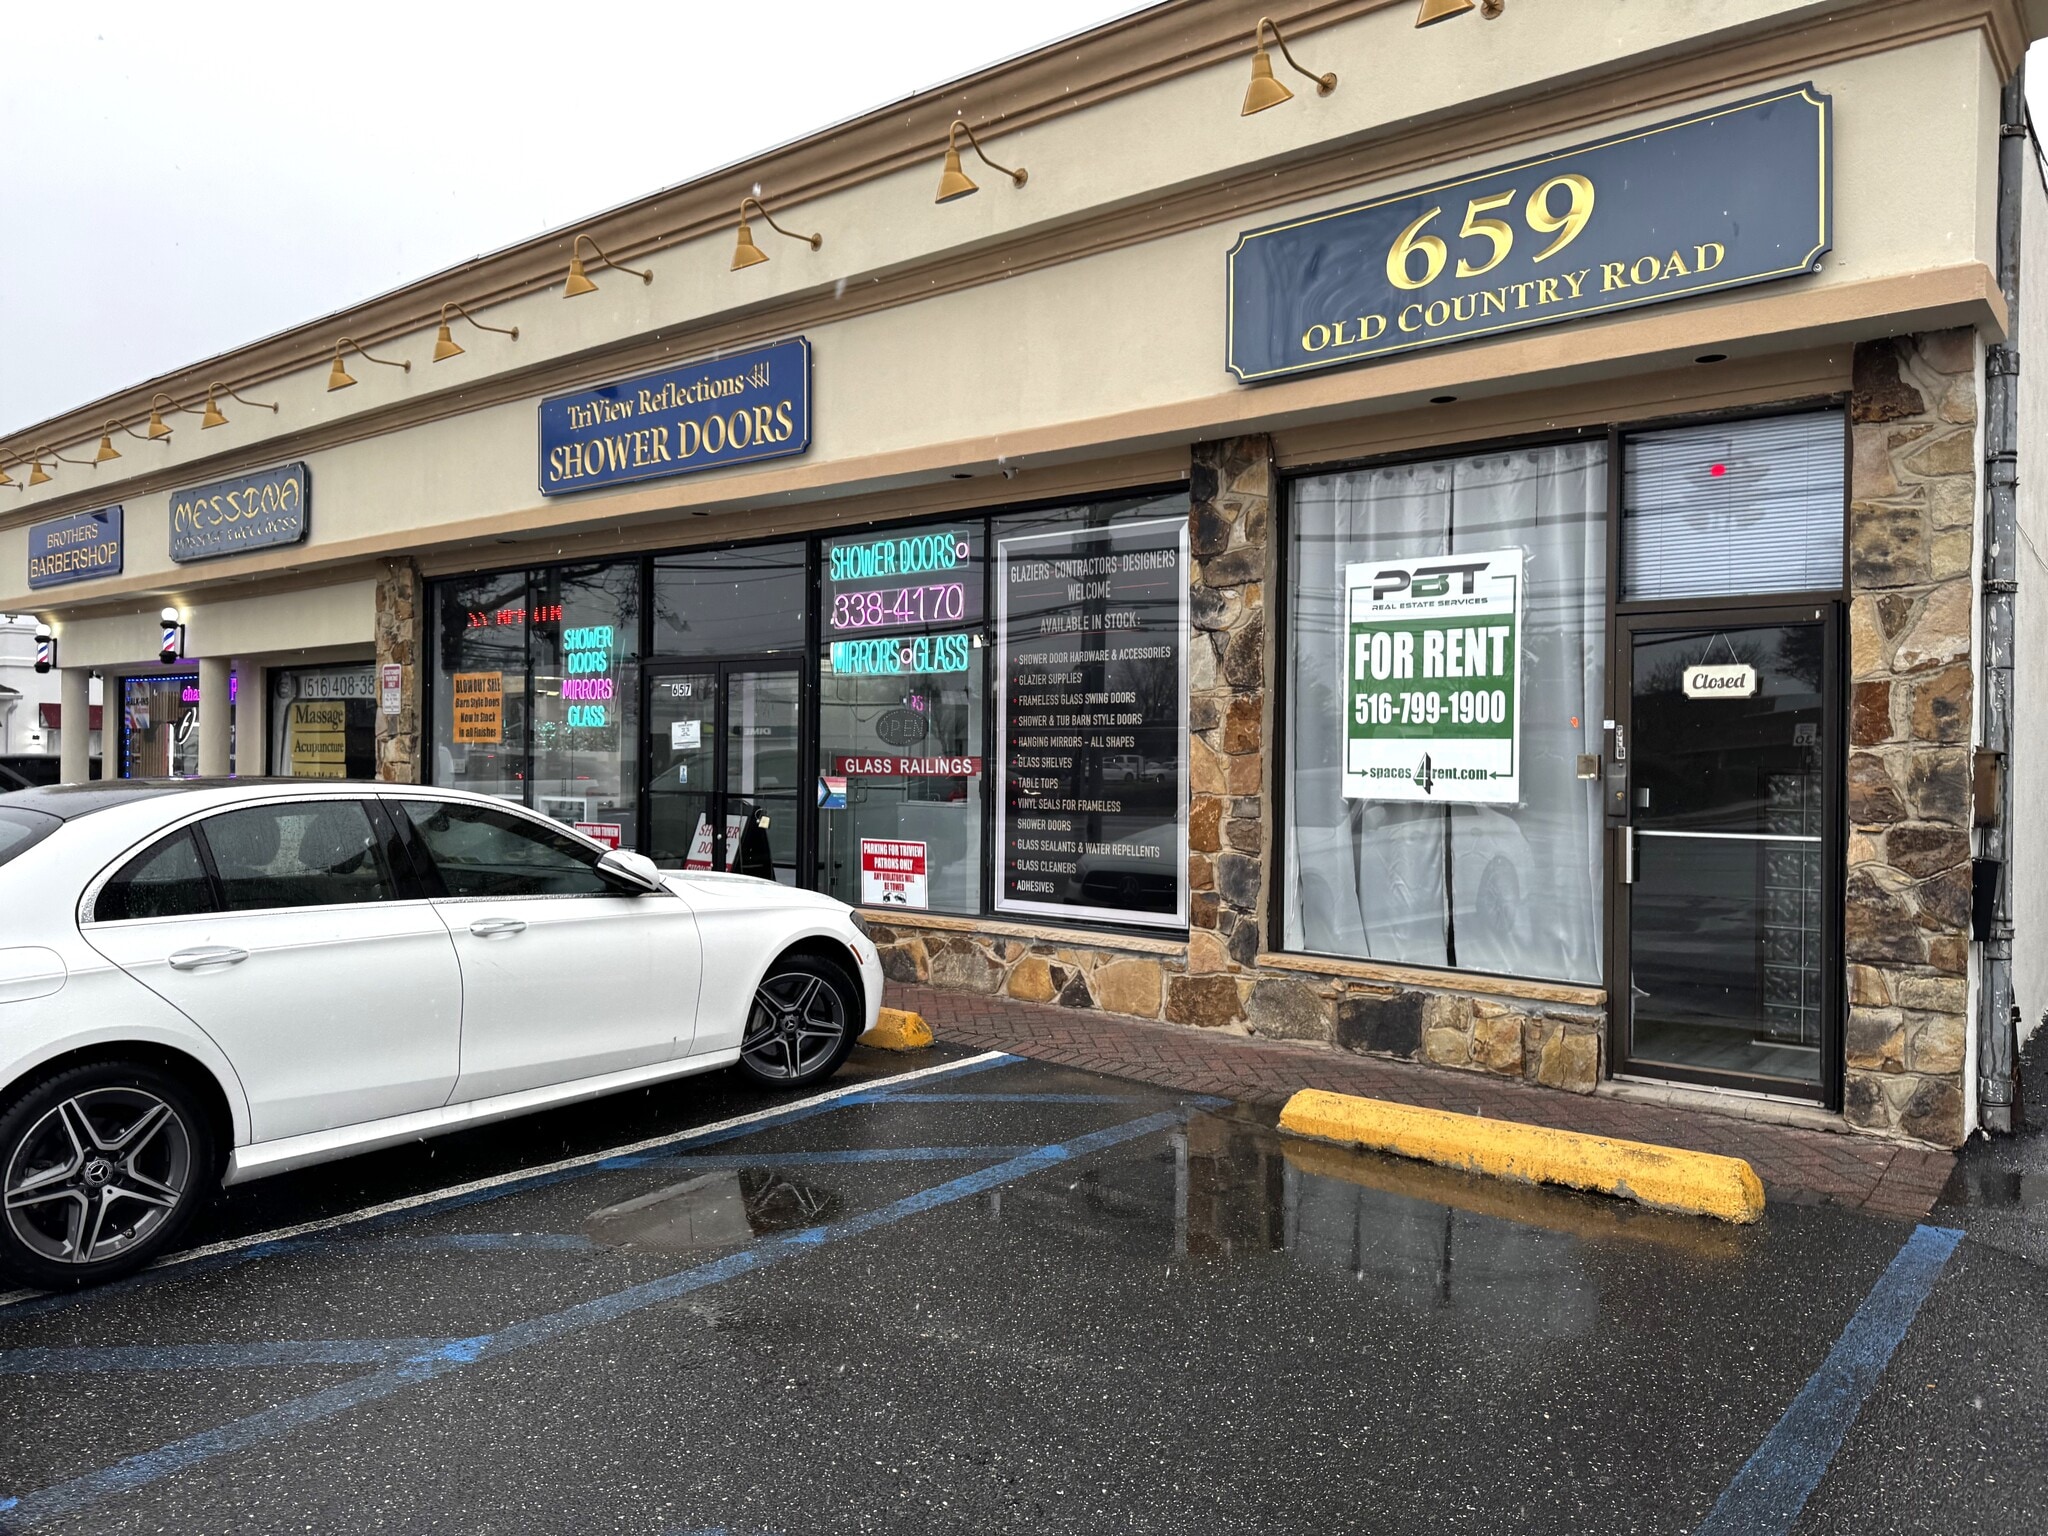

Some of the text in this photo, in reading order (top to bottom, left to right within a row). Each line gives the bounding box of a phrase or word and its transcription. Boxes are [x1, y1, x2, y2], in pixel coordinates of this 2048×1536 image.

[1385, 173, 1596, 290] 659
[1300, 241, 1726, 353] OLD COUNTRY ROAD
[567, 374, 745, 430] TriView Reflections
[550, 400, 794, 482] SHOWER DOORS
[174, 478, 299, 533] MESSINA
[47, 523, 98, 549] BROTHERS
[30, 542, 117, 578] BARBERSHOP
[830, 533, 956, 580] SHOWER DOORS
[1067, 581, 1111, 601] WELCOME
[1373, 562, 1491, 601] PBT
[835, 585, 963, 627] 338-4170
[1372, 597, 1489, 611] REAL ESTATE SERVICES
[1040, 612, 1141, 634] AVAILABLE IN STOCK:
[563, 626, 613, 650] SHOWER
[568, 651, 607, 674] DOORS
[833, 634, 968, 674] MIRRORS GLASS
[1019, 646, 1171, 665] SHOWER DOOR HARDWARE & ACCESSORIES
[1354, 625, 1510, 681] FOR RENT
[304, 676, 375, 697] (516)408-38
[562, 678, 613, 700] MIRRORS
[1019, 673, 1082, 686] GLAZIER SUPPLIES
[1692, 673, 1746, 690] Closed
[672, 684, 691, 696] 657
[1018, 692, 1136, 706] FRAMELESS GLASS SWING DOORS
[456, 697, 500, 708] Barn Style Doors
[1355, 689, 1506, 725] 516-799-1900
[295, 704, 344, 730] Massage
[568, 705, 606, 727] GLASS
[1018, 713, 1143, 727] SHOWER & TUB BARN STYLE DOORS
[879, 719, 924, 737] OPEN
[294, 740, 344, 757] Acupuncture
[1018, 736, 1049, 748] HANGING
[1050, 736, 1082, 748] MIRRORS
[1091, 736, 1104, 748] ALL
[1106, 736, 1135, 748] SHAPES
[845, 758, 973, 774] GLASS RAILINGS
[1018, 756, 1072, 768] GLASS SHELVES
[1018, 777, 1059, 789] TABLE TOPS
[1018, 798, 1121, 812] VINYL SEALS FOR FRAMELESS
[699, 824, 740, 839] SHER
[1017, 818, 1072, 832] SHOWER DOORS
[863, 842, 924, 858] PARKING FOR TRIVIEW
[1017, 839, 1160, 858] GLASS SEALANTS & WATER REPELLENTS
[874, 857, 913, 871] PATRONS ONLY
[1017, 859, 1077, 874] GLASS CLEANERS
[1016, 879, 1054, 894] ADHESIVES
